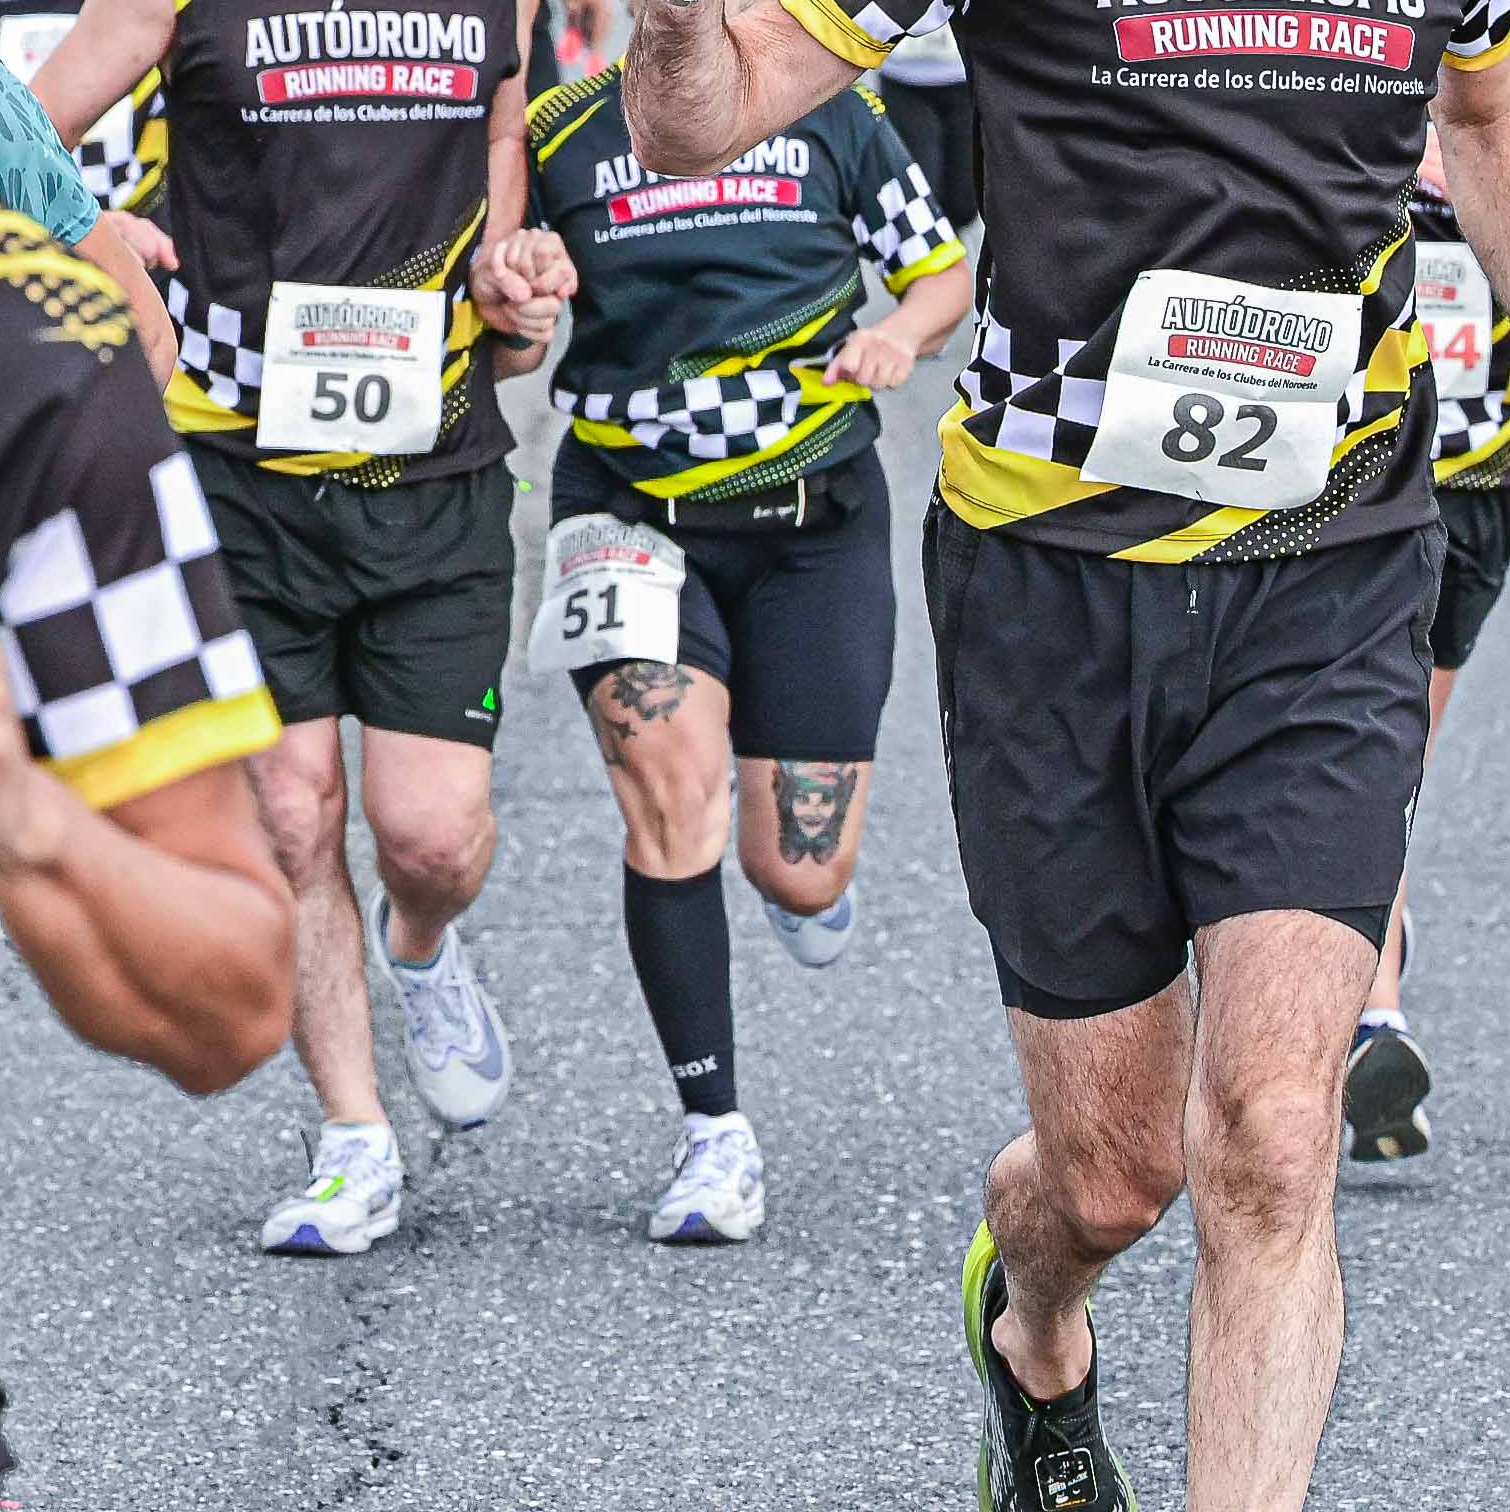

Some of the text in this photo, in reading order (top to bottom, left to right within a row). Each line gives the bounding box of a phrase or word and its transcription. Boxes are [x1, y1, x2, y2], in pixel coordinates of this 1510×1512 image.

[1150, 14, 1388, 62] RUNNING RACE
[284, 65, 454, 98] RUNNING RACE
[1091, 65, 1425, 95] La Carrera de los Clubes del Noroeste
[260, 106, 312, 122] Carrera
[314, 105, 332, 121] de
[334, 105, 356, 121] los
[357, 104, 407, 121] Clubes
[627, 178, 778, 218] RUNNING RACE
[1161, 295, 1333, 353] AUTÓDROMO
[1148, 356, 1318, 390] La Carrera de los Clubes del Noroeste
[1186, 338, 1302, 373] RUNNING RACE
[311, 371, 391, 424] 50
[1162, 393, 1277, 472] 82
[562, 583, 624, 640] 51
